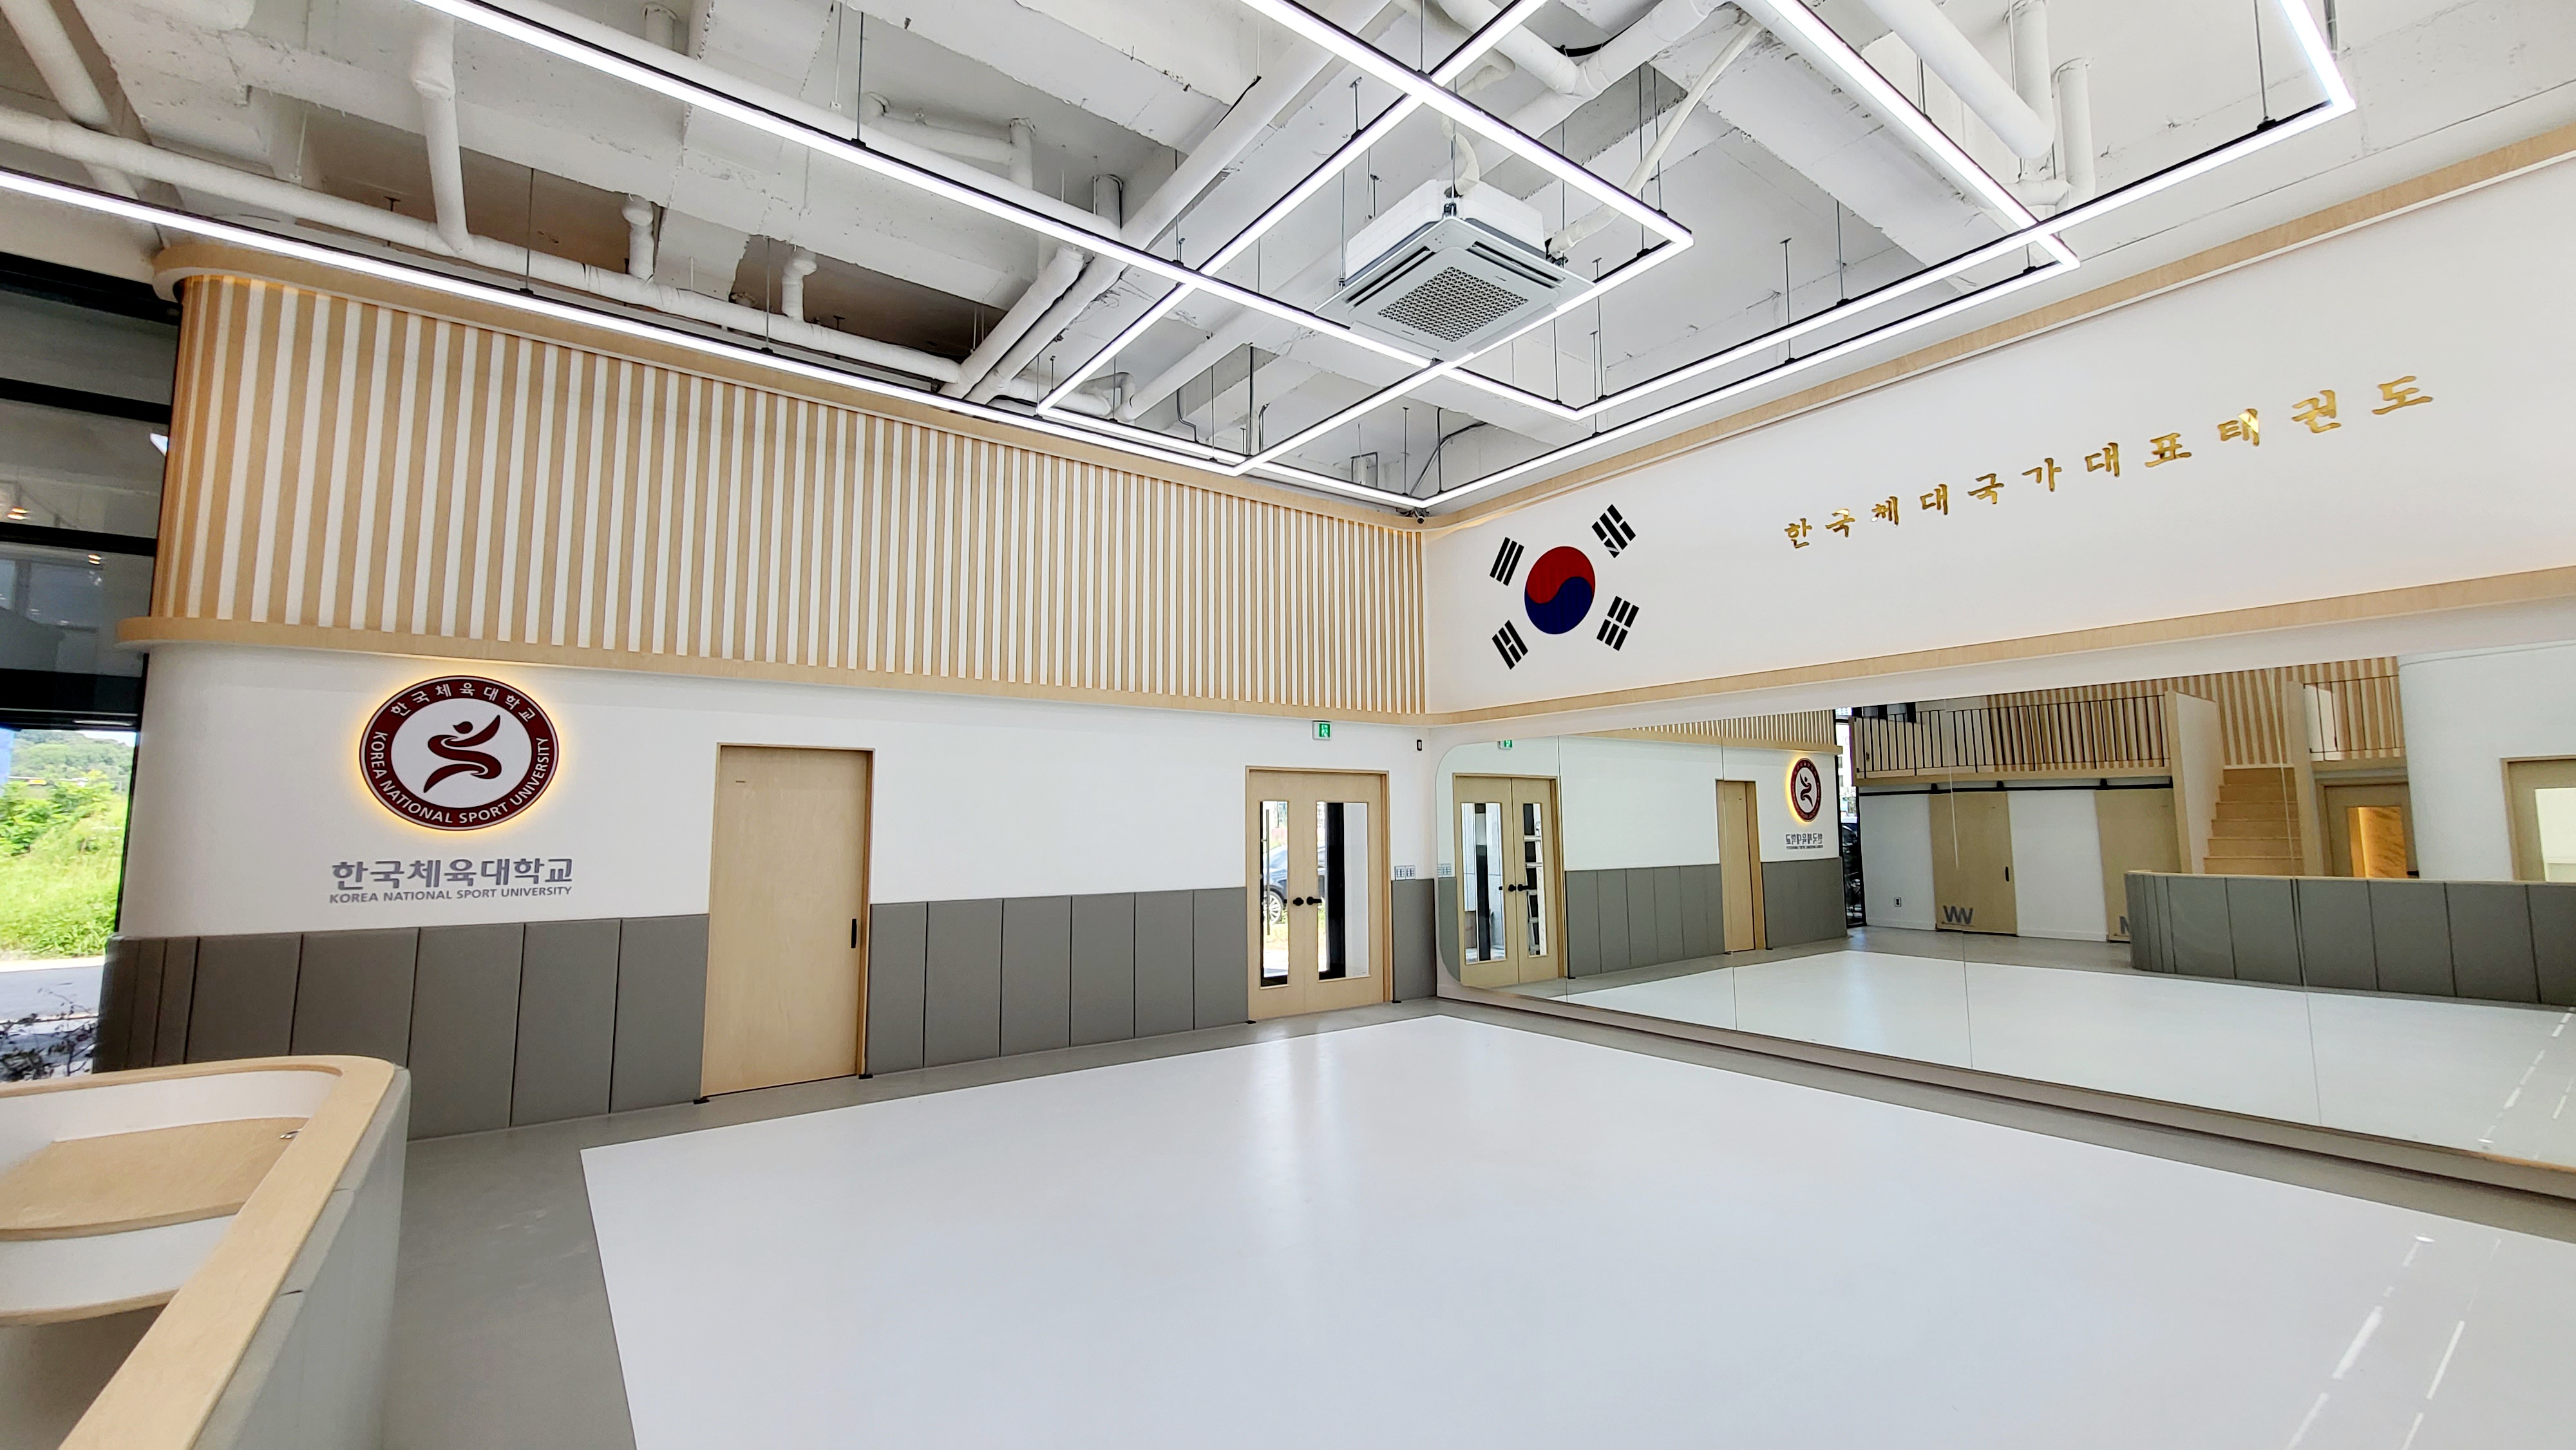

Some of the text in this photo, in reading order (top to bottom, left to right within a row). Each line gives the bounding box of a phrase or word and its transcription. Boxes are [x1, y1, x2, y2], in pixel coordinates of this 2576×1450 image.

[390, 682, 536, 722] 한국체육대학교
[370, 731, 550, 824] KOREA NATIONAL SPORT UNIVERSITY
[331, 858, 573, 890] 한국체육대학교
[329, 886, 572, 904] KOREA NATIONAL SPORT UNIVERSITY
